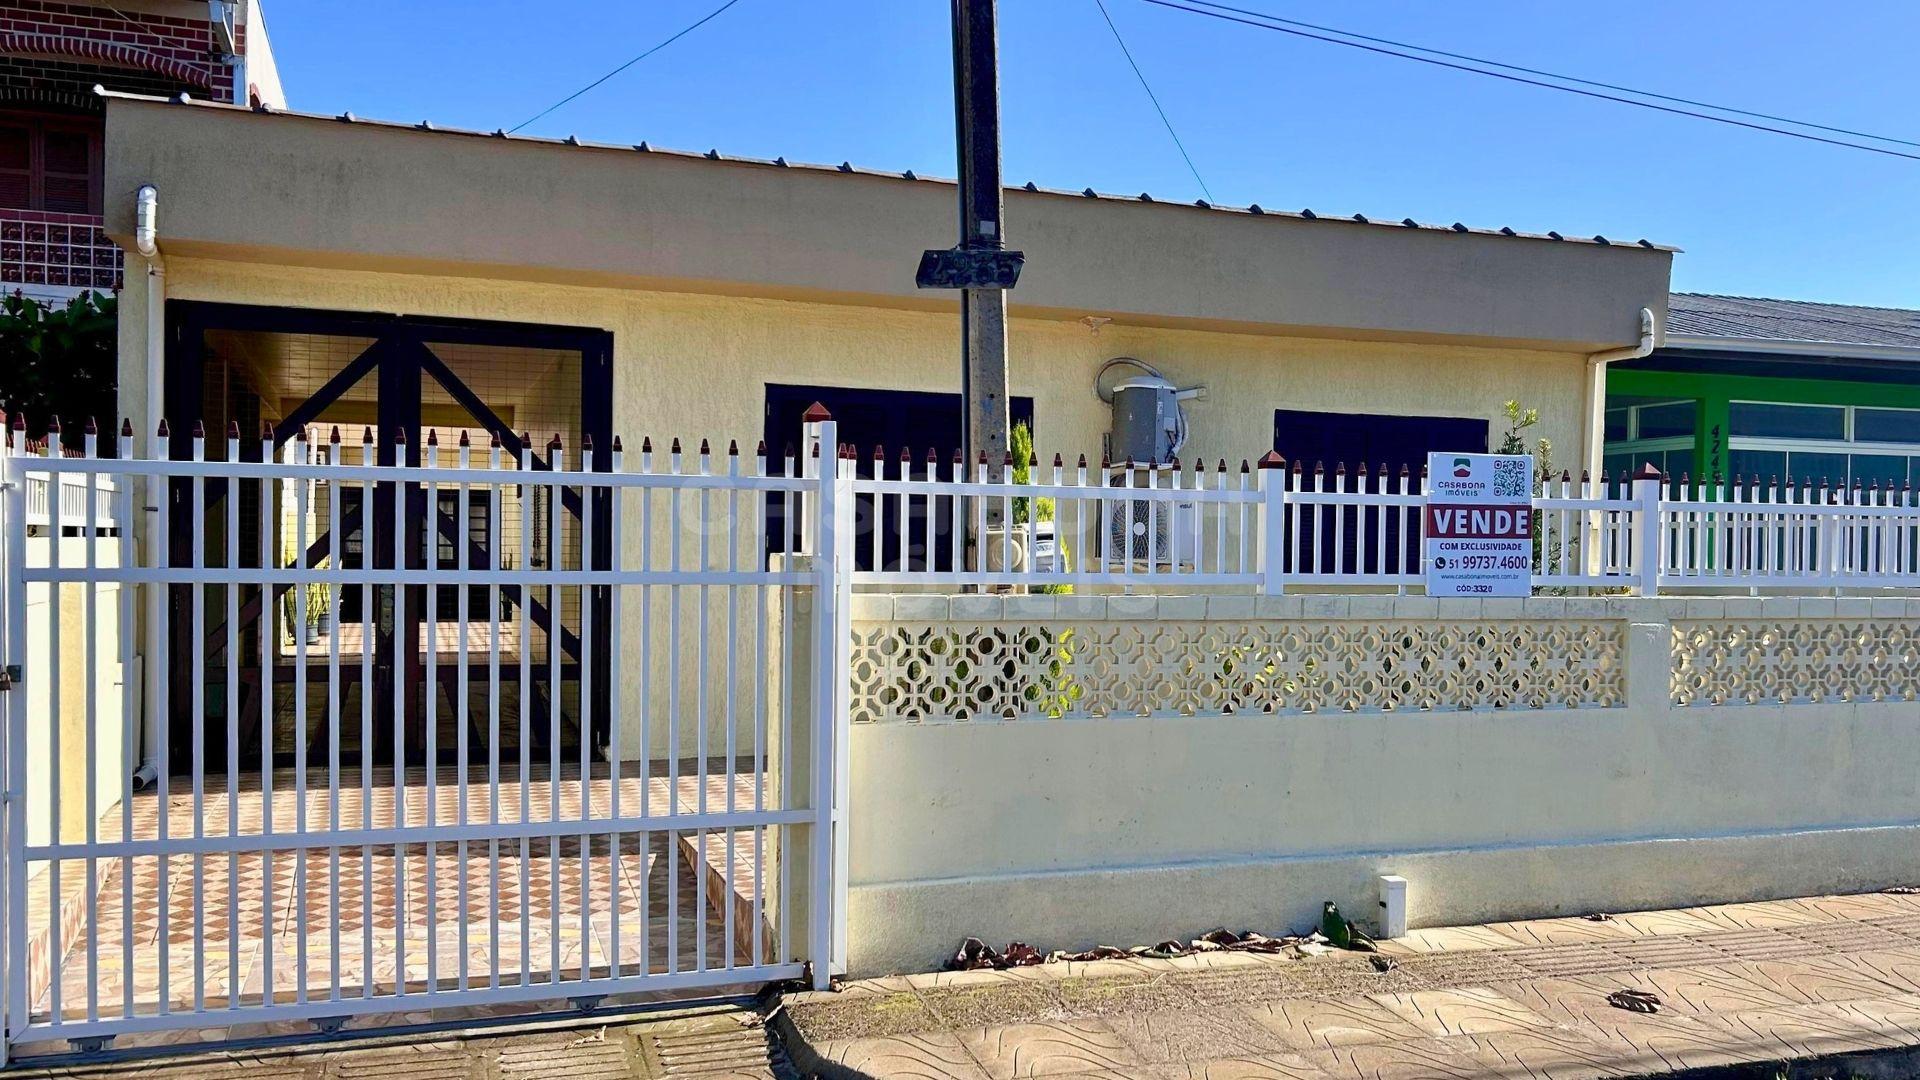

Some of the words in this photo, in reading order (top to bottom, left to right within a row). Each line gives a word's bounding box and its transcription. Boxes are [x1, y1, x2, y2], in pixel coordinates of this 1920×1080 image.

[1438, 481, 1486, 489] CASABONA
[1433, 509, 1528, 535] VENDE
[1439, 542, 1459, 550] COM
[1460, 542, 1522, 551] EXCLUSIVIDADE
[1449, 559, 1459, 568] 51
[1462, 556, 1528, 570] 99737.4600
